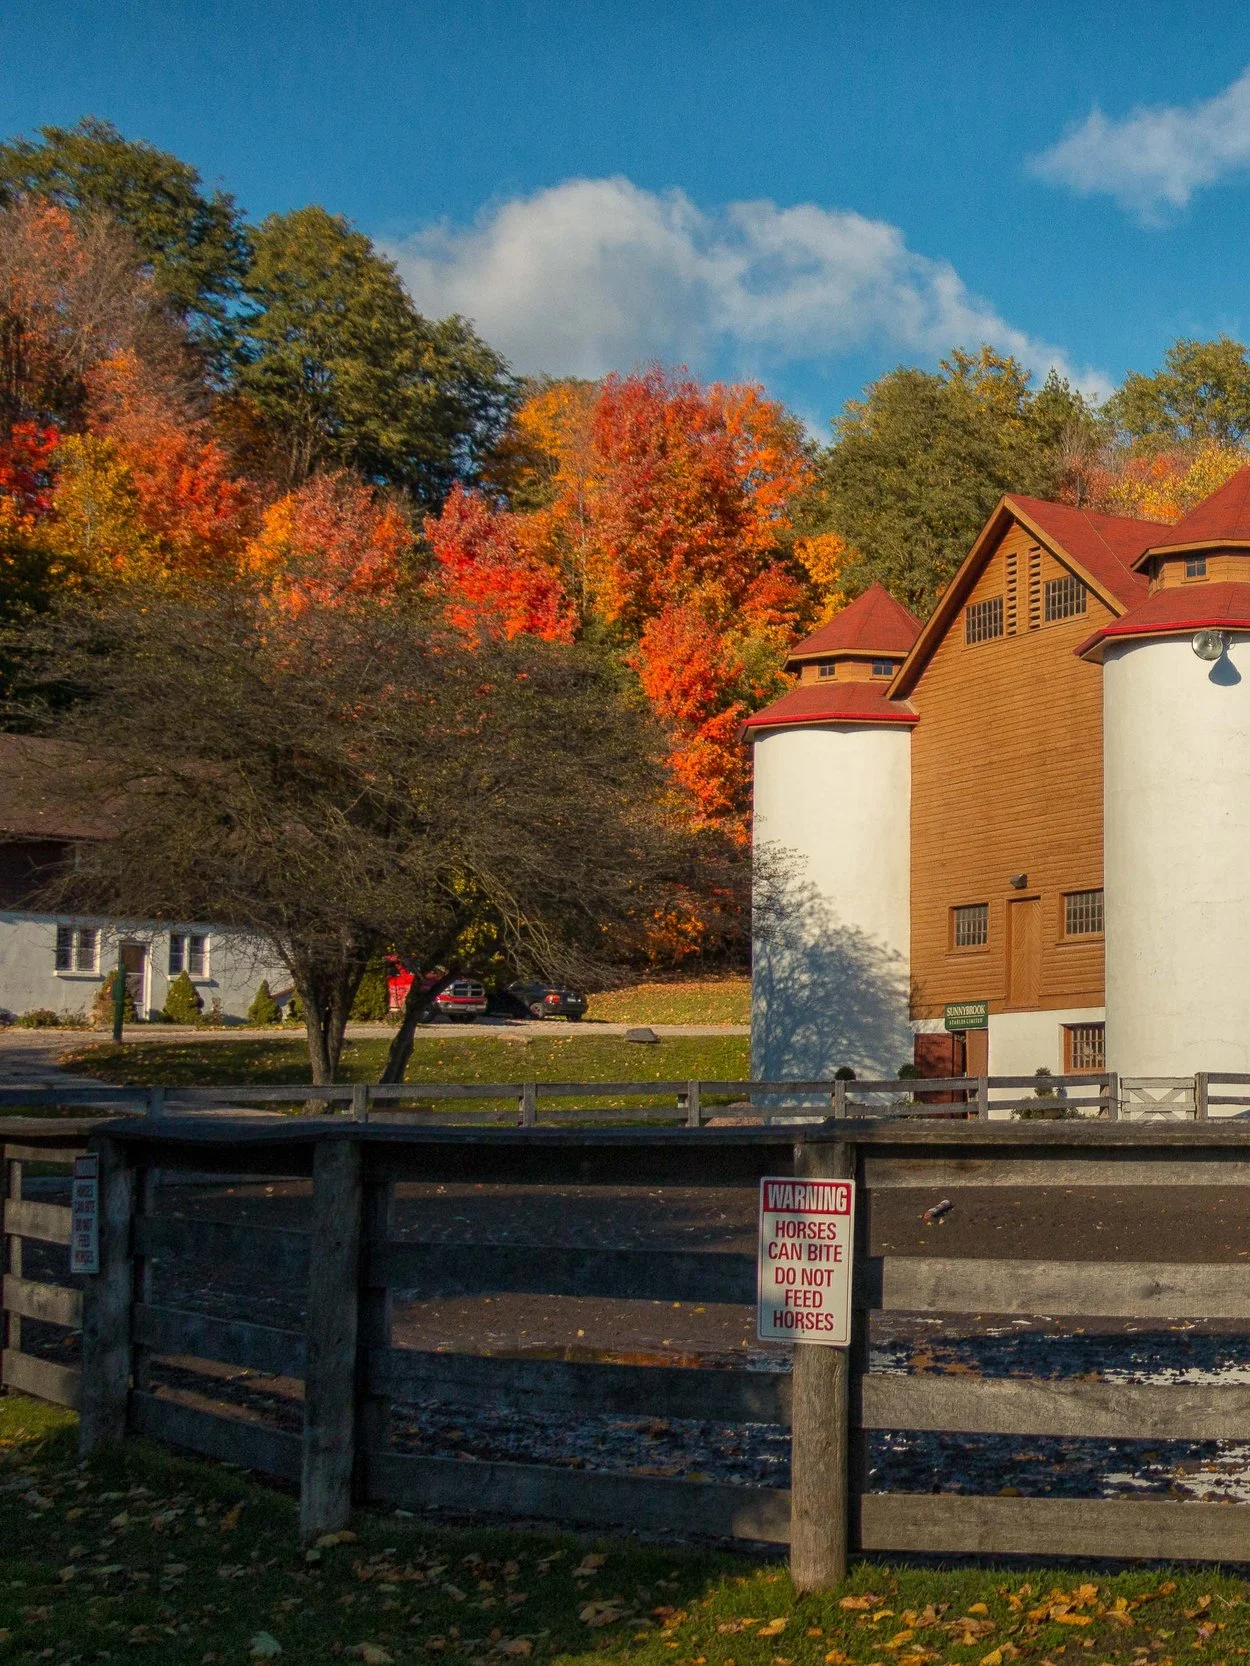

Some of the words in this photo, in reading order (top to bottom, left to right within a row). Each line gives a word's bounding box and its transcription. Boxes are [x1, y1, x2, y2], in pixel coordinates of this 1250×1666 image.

[946, 1004, 985, 1017] SUNNYBROOK
[768, 1183, 848, 1212] WARNING
[775, 1220, 837, 1240] HORSES
[768, 1242, 802, 1260] CAN
[807, 1244, 842, 1263] BITE
[774, 1267, 797, 1285] DO
[801, 1268, 834, 1287] NOT
[784, 1289, 823, 1308] FEED
[773, 1310, 834, 1331] HORSES
